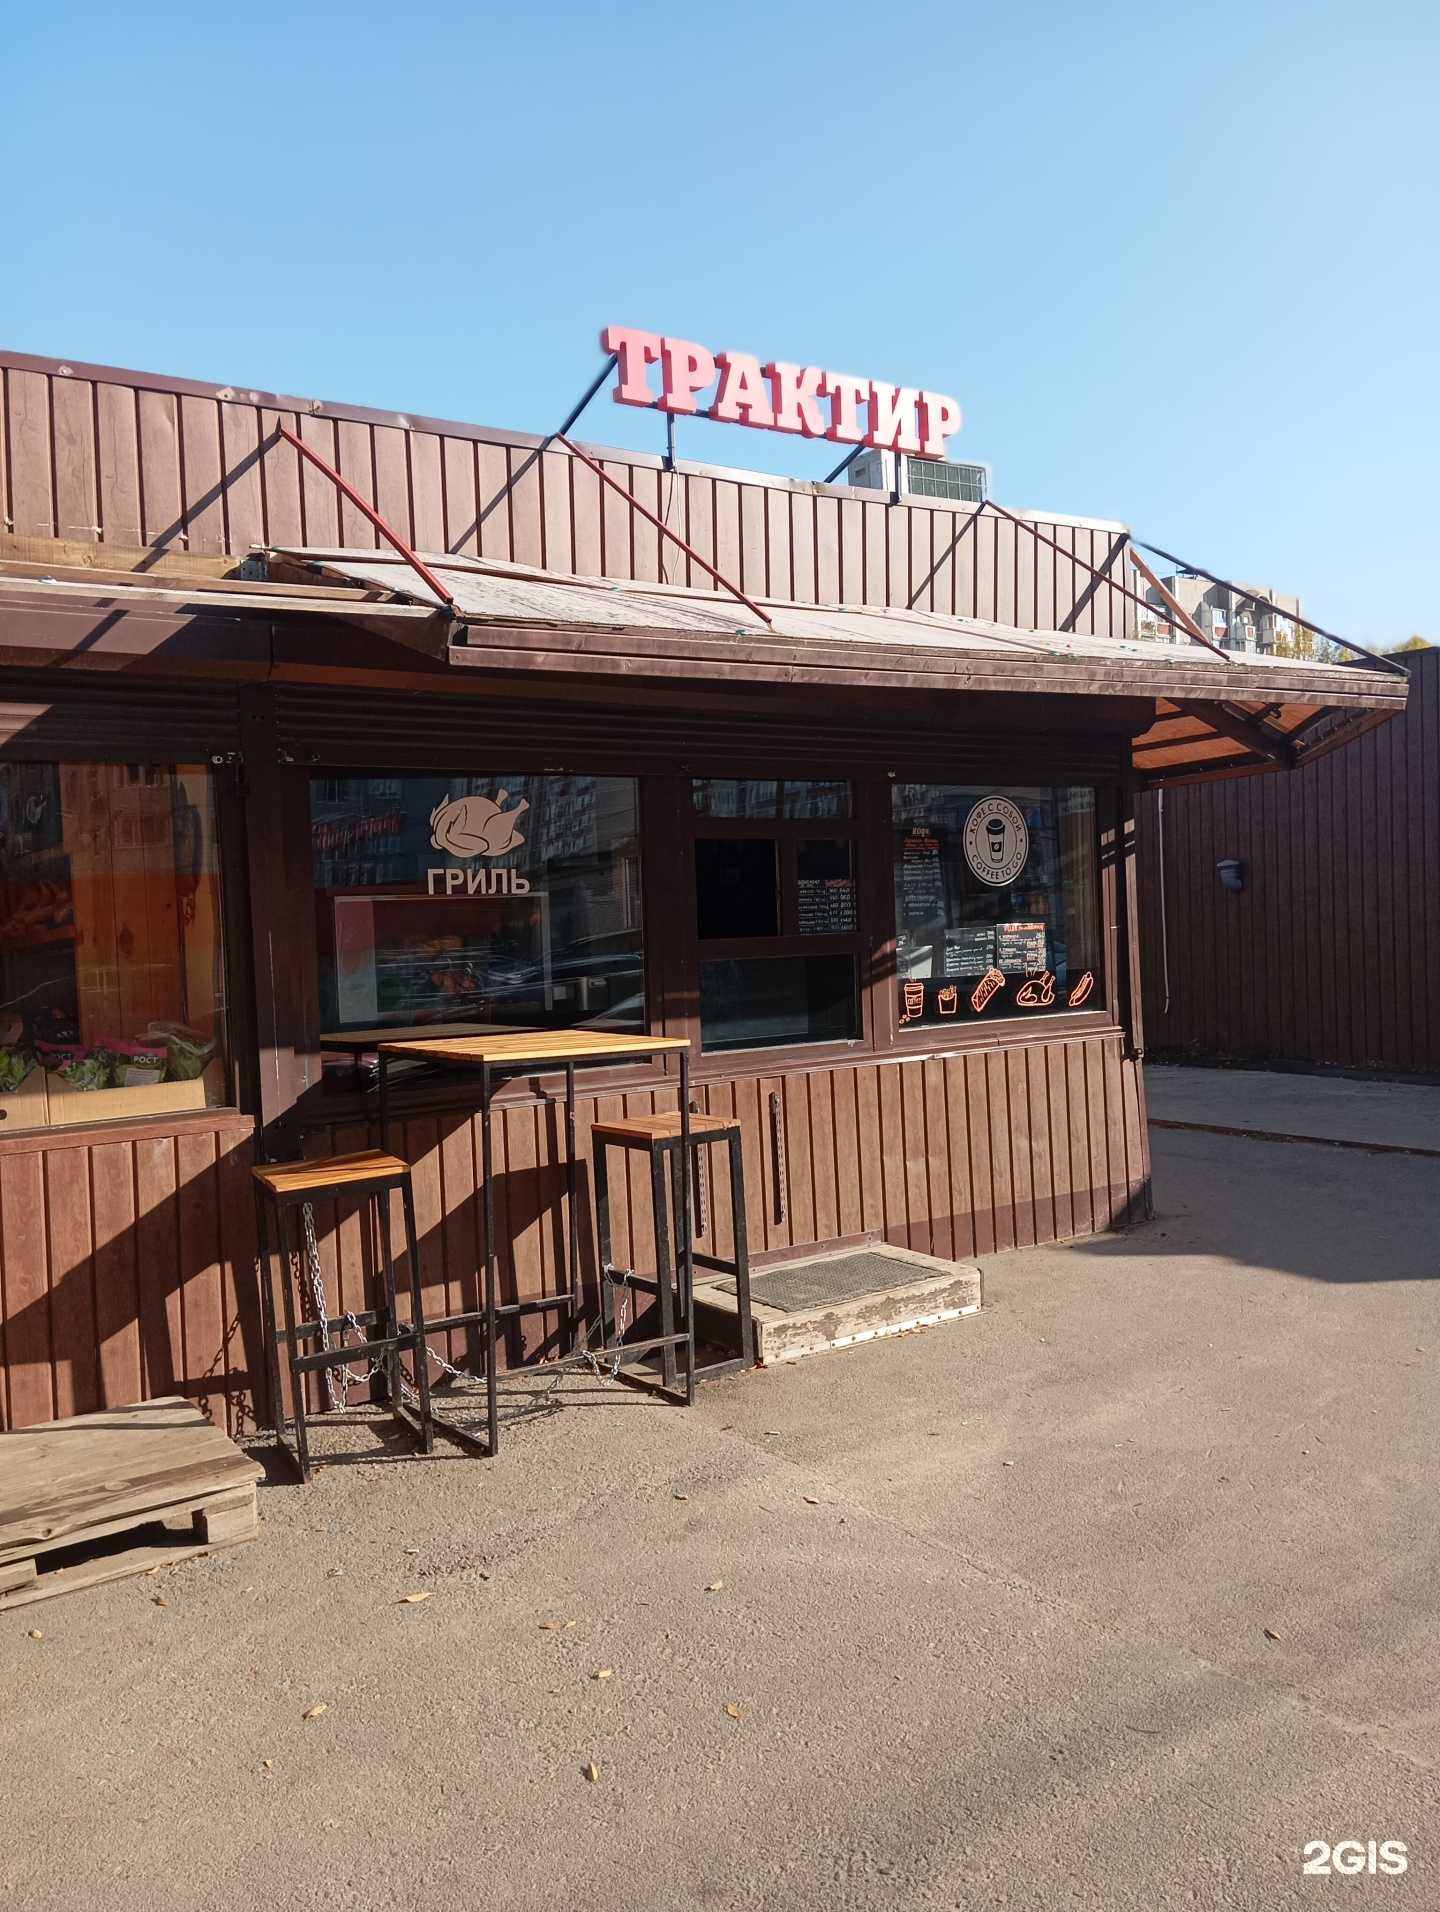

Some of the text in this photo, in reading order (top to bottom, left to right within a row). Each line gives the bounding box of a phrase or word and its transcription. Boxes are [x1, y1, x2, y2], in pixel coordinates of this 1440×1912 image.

[601, 325, 963, 460] ТРАКТИР
[969, 807, 987, 834] КОФЕ
[971, 852, 1023, 880] COFFEE TO GO
[427, 868, 531, 896] ГРИЛЬ
[133, 1055, 159, 1064] РОСТ
